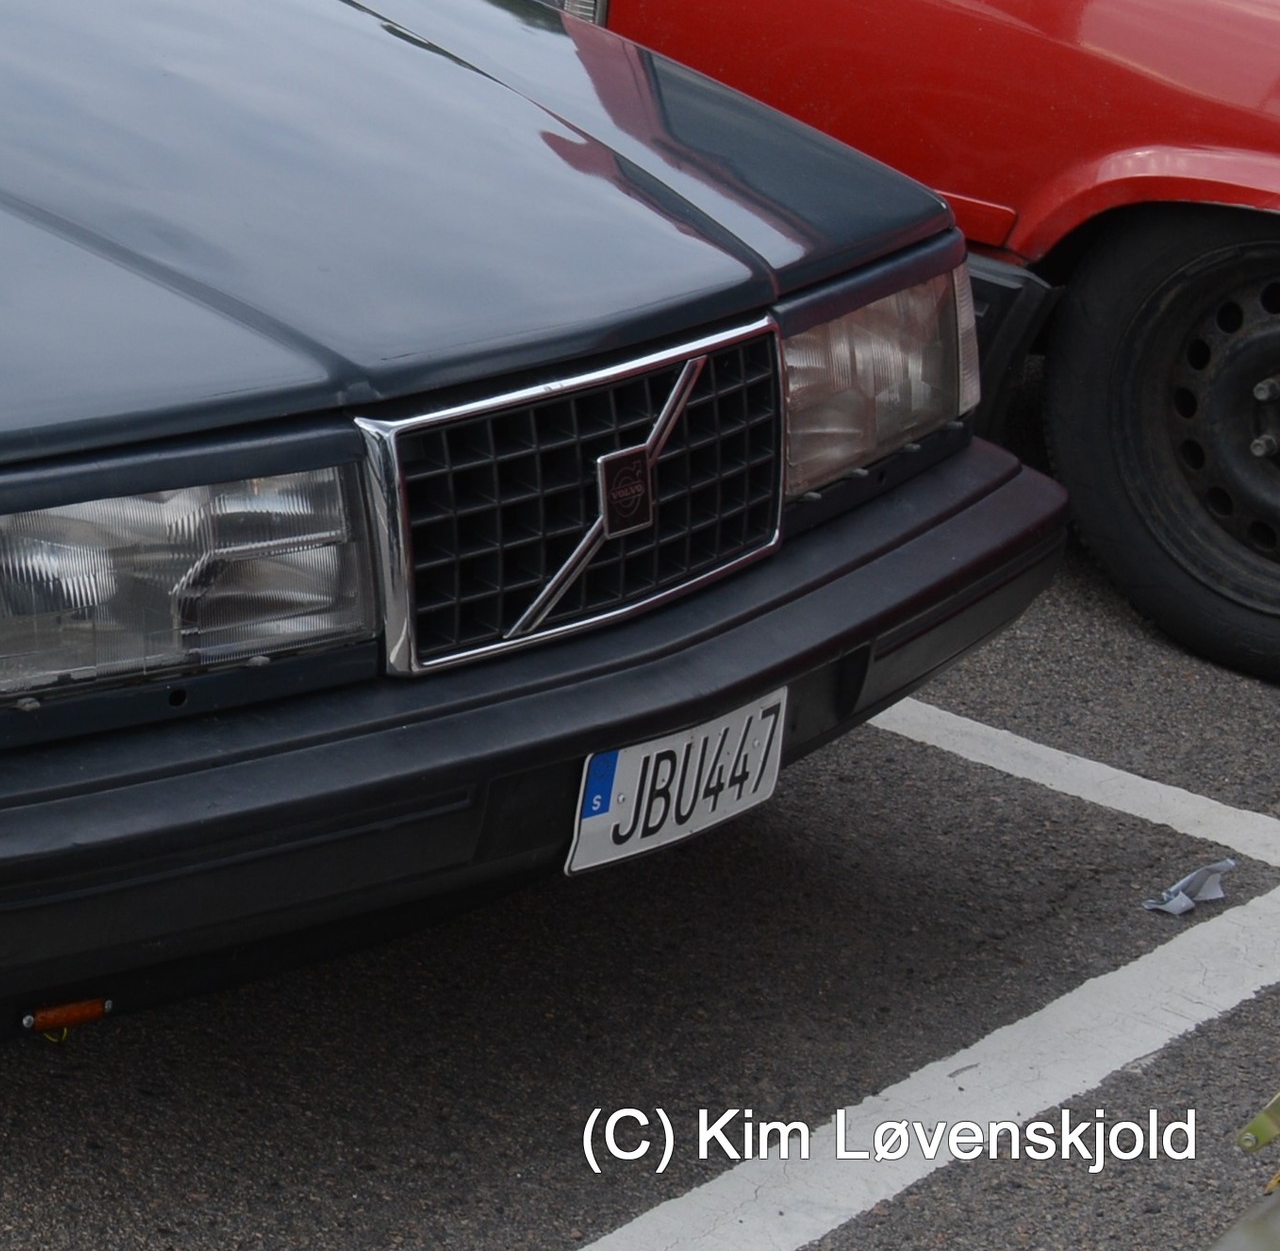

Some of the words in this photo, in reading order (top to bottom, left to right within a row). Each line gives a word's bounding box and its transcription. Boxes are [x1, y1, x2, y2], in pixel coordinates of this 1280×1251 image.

[611, 483, 643, 500] VOLVO
[610, 702, 781, 846] JBU447
[591, 795, 603, 811] S
